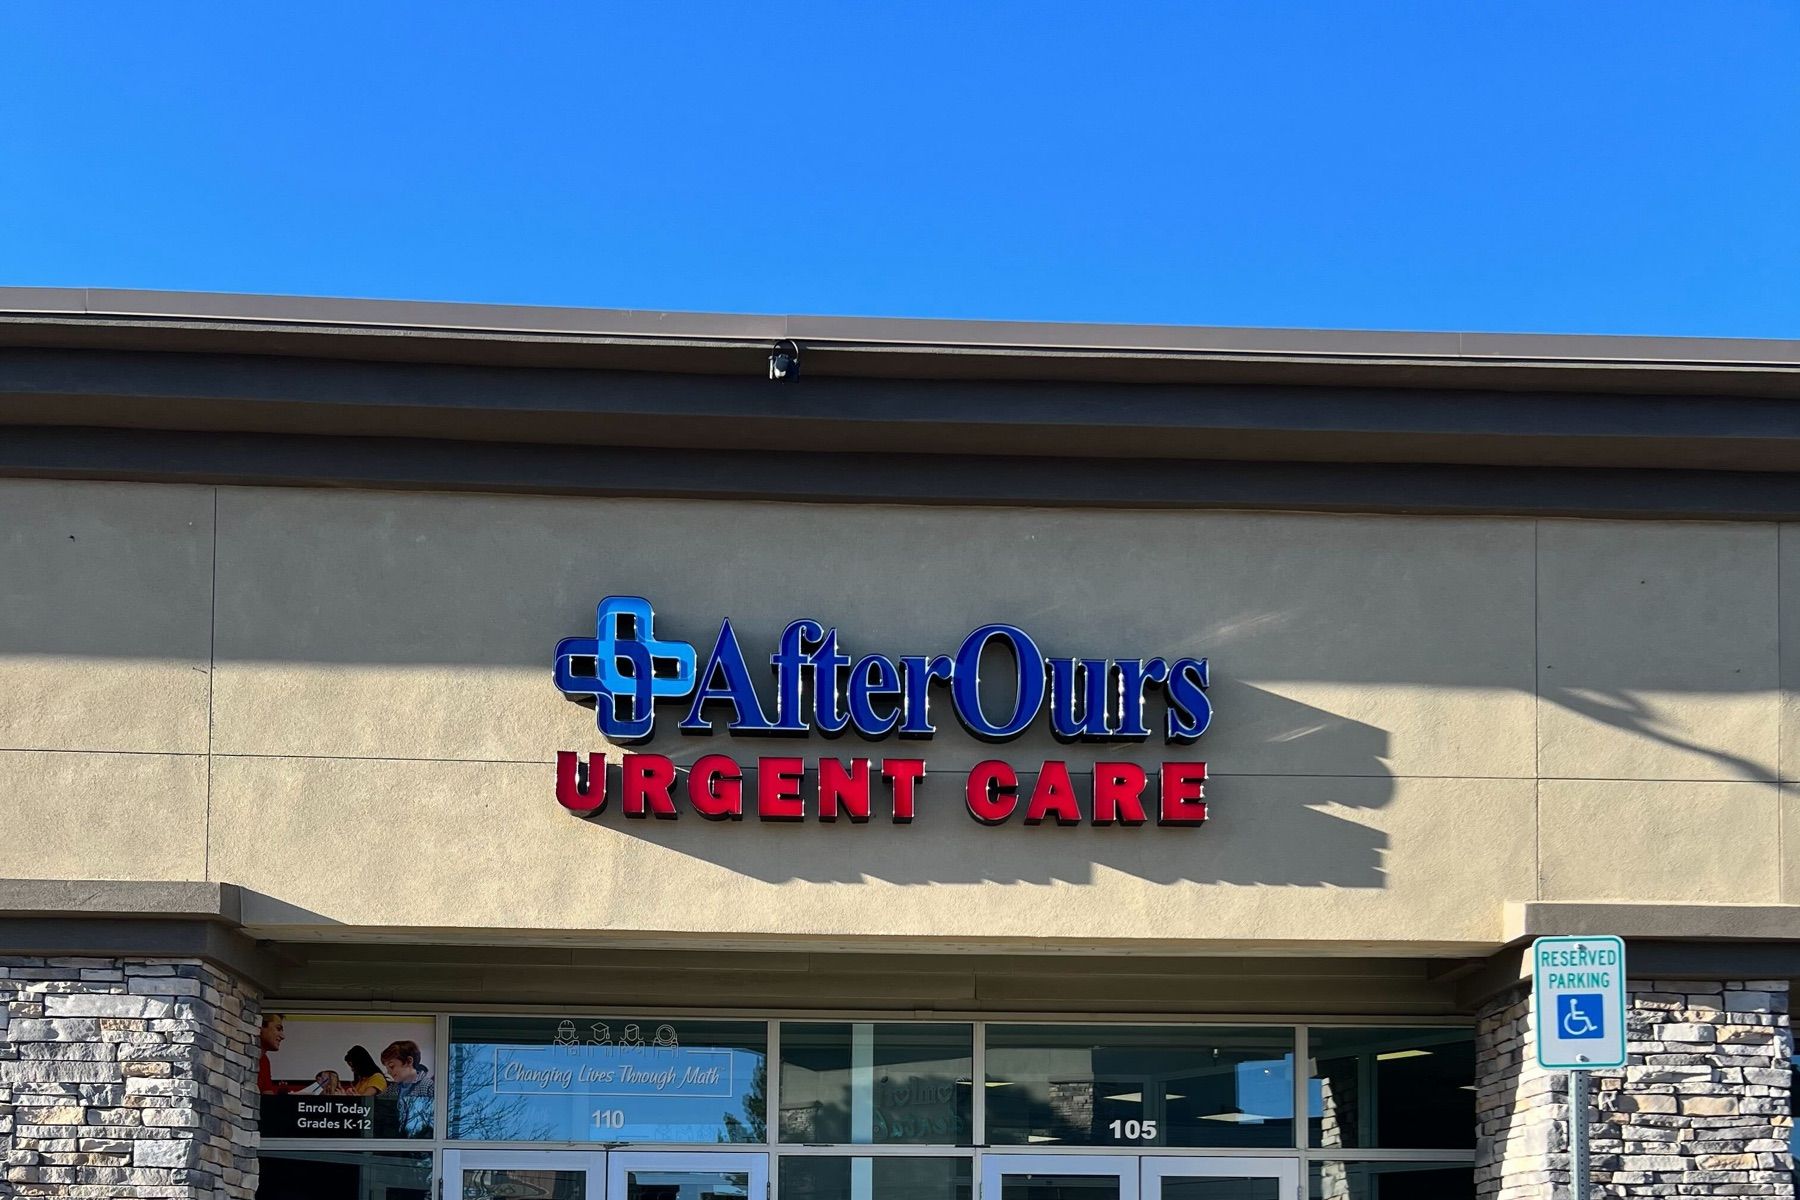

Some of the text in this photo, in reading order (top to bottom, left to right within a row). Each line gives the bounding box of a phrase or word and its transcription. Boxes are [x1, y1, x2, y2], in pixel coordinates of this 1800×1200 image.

[678, 616, 1214, 742] AfterOurs
[554, 751, 1209, 826] URGENT CARE
[1541, 949, 1617, 967] RESERVED
[1549, 972, 1611, 989] PARKING
[504, 1061, 721, 1090] Changing Lives Through Math
[297, 1102, 371, 1117] Enroll Today
[592, 1109, 625, 1128] 110
[297, 1118, 372, 1130] Grades K-12
[1109, 1119, 1157, 1140] 105
